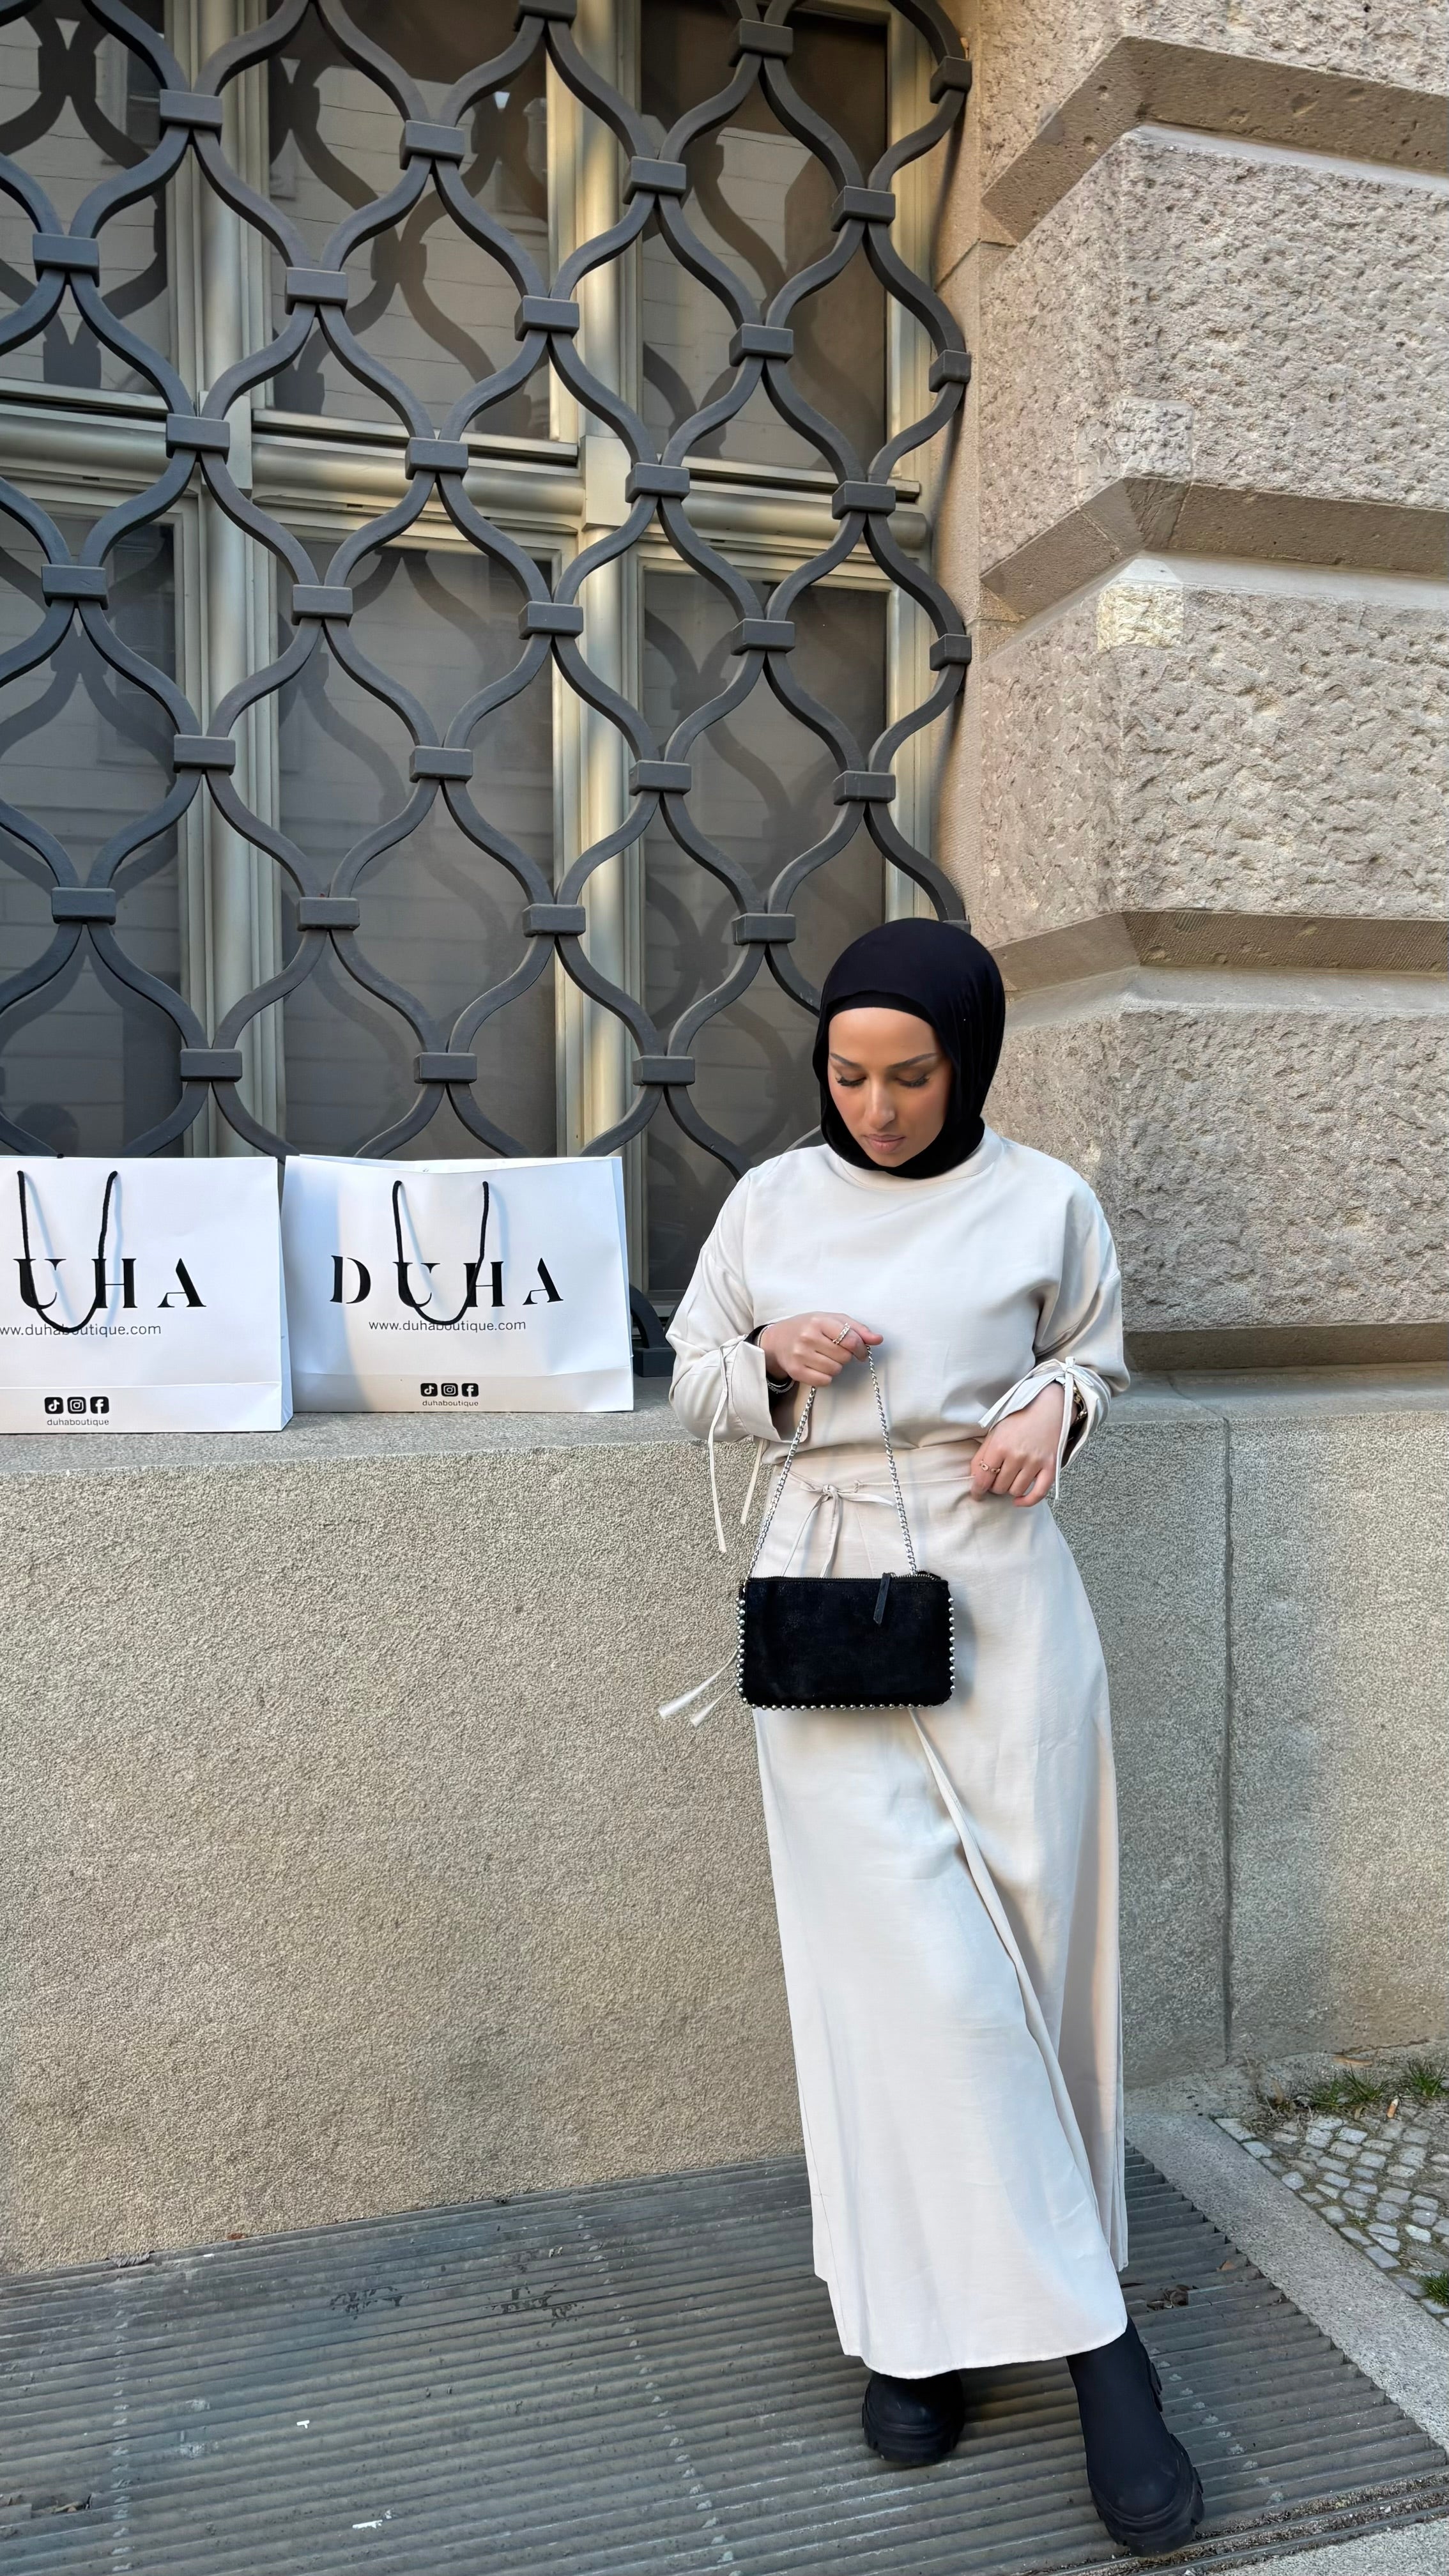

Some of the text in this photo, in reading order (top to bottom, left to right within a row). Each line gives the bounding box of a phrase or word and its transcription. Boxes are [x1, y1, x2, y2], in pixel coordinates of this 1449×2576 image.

[13, 1258, 207, 1310] UHA
[329, 1255, 564, 1308] DUHA
[47, 1418, 109, 1427] duhaboutique
